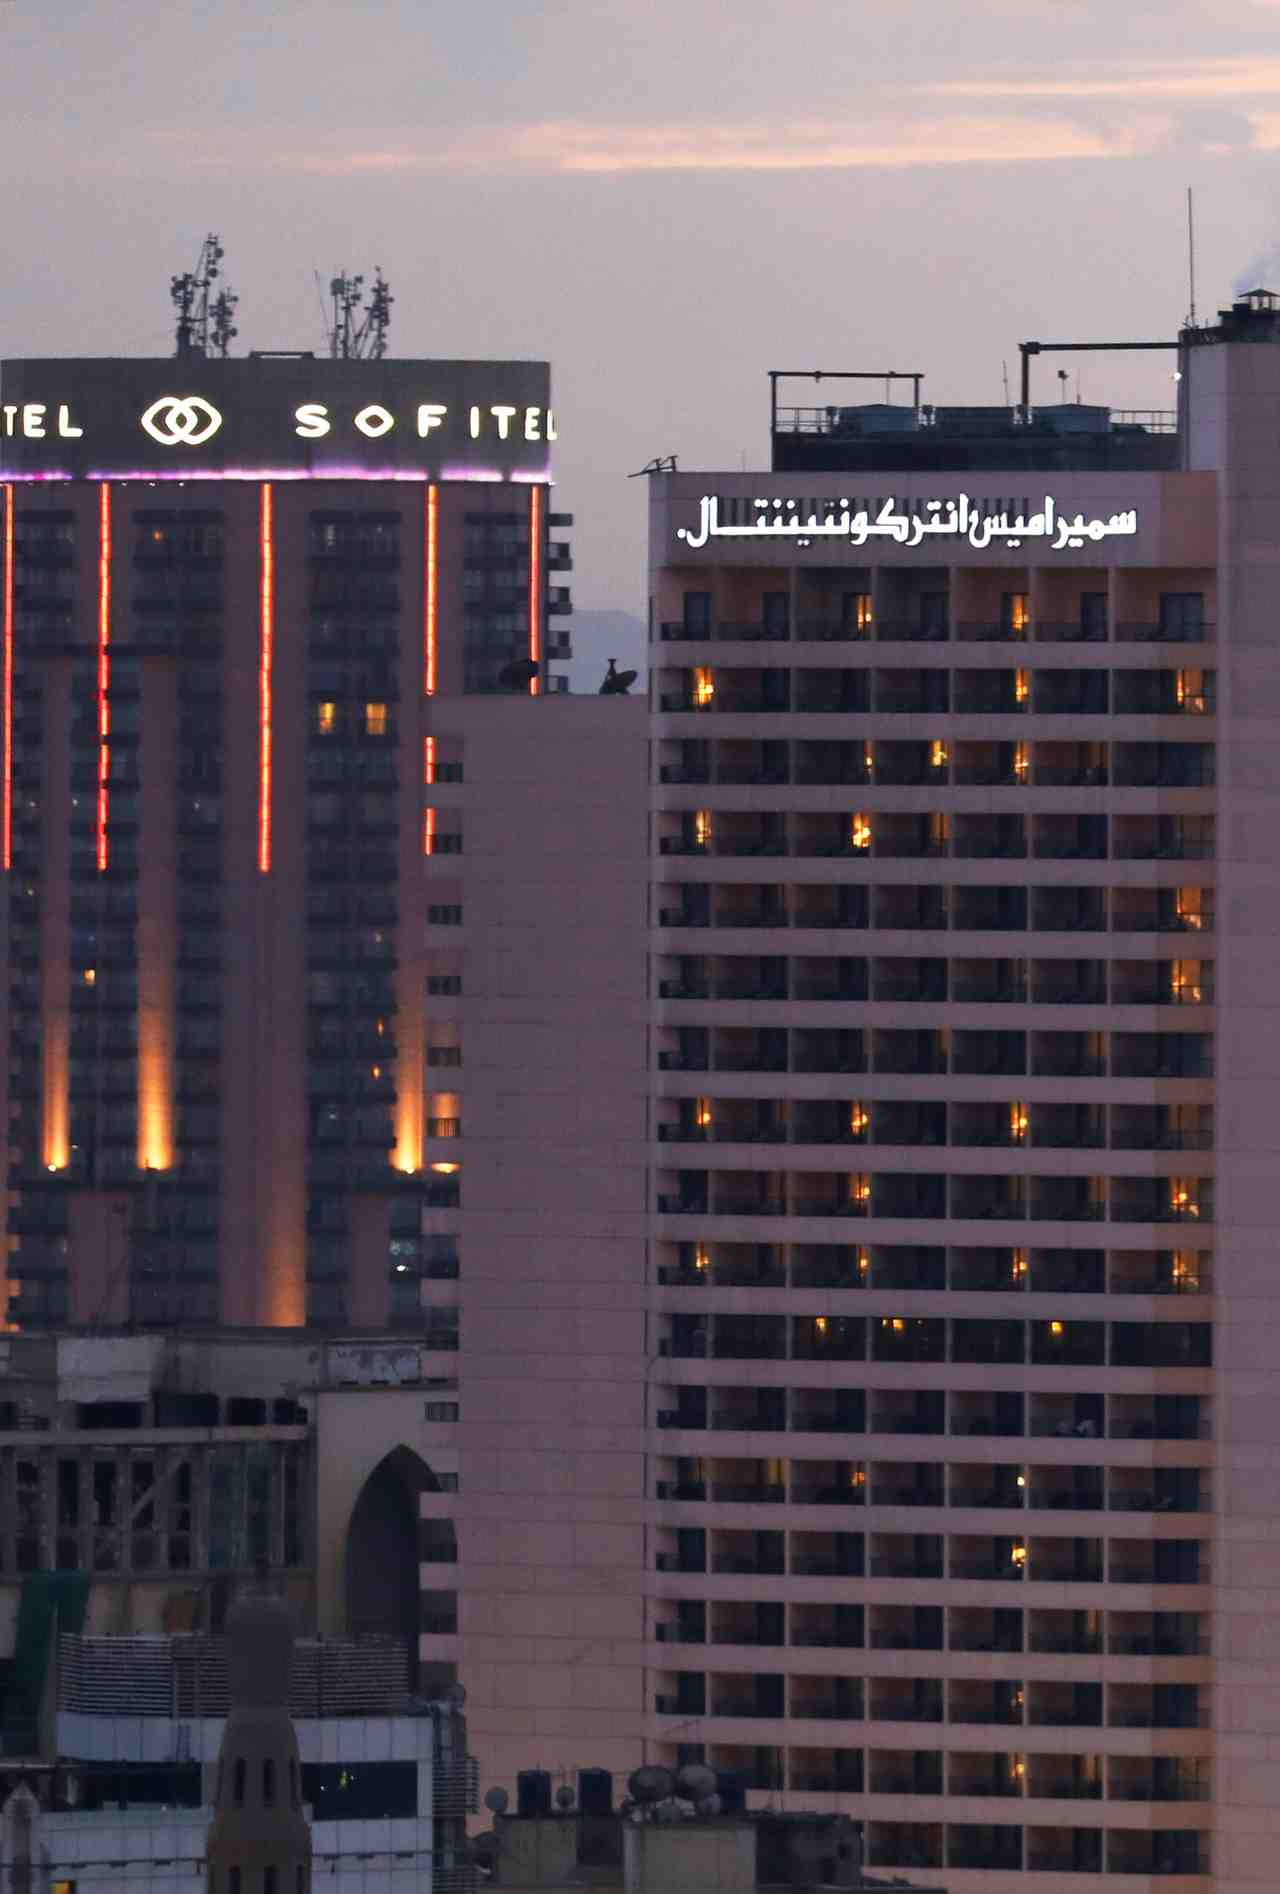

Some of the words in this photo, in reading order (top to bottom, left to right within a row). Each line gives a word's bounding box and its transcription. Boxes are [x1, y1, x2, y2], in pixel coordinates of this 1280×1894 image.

[3, 404, 84, 438] TEL
[294, 403, 559, 441] SOFITEL
[968, 496, 1137, 548] سميراميس
